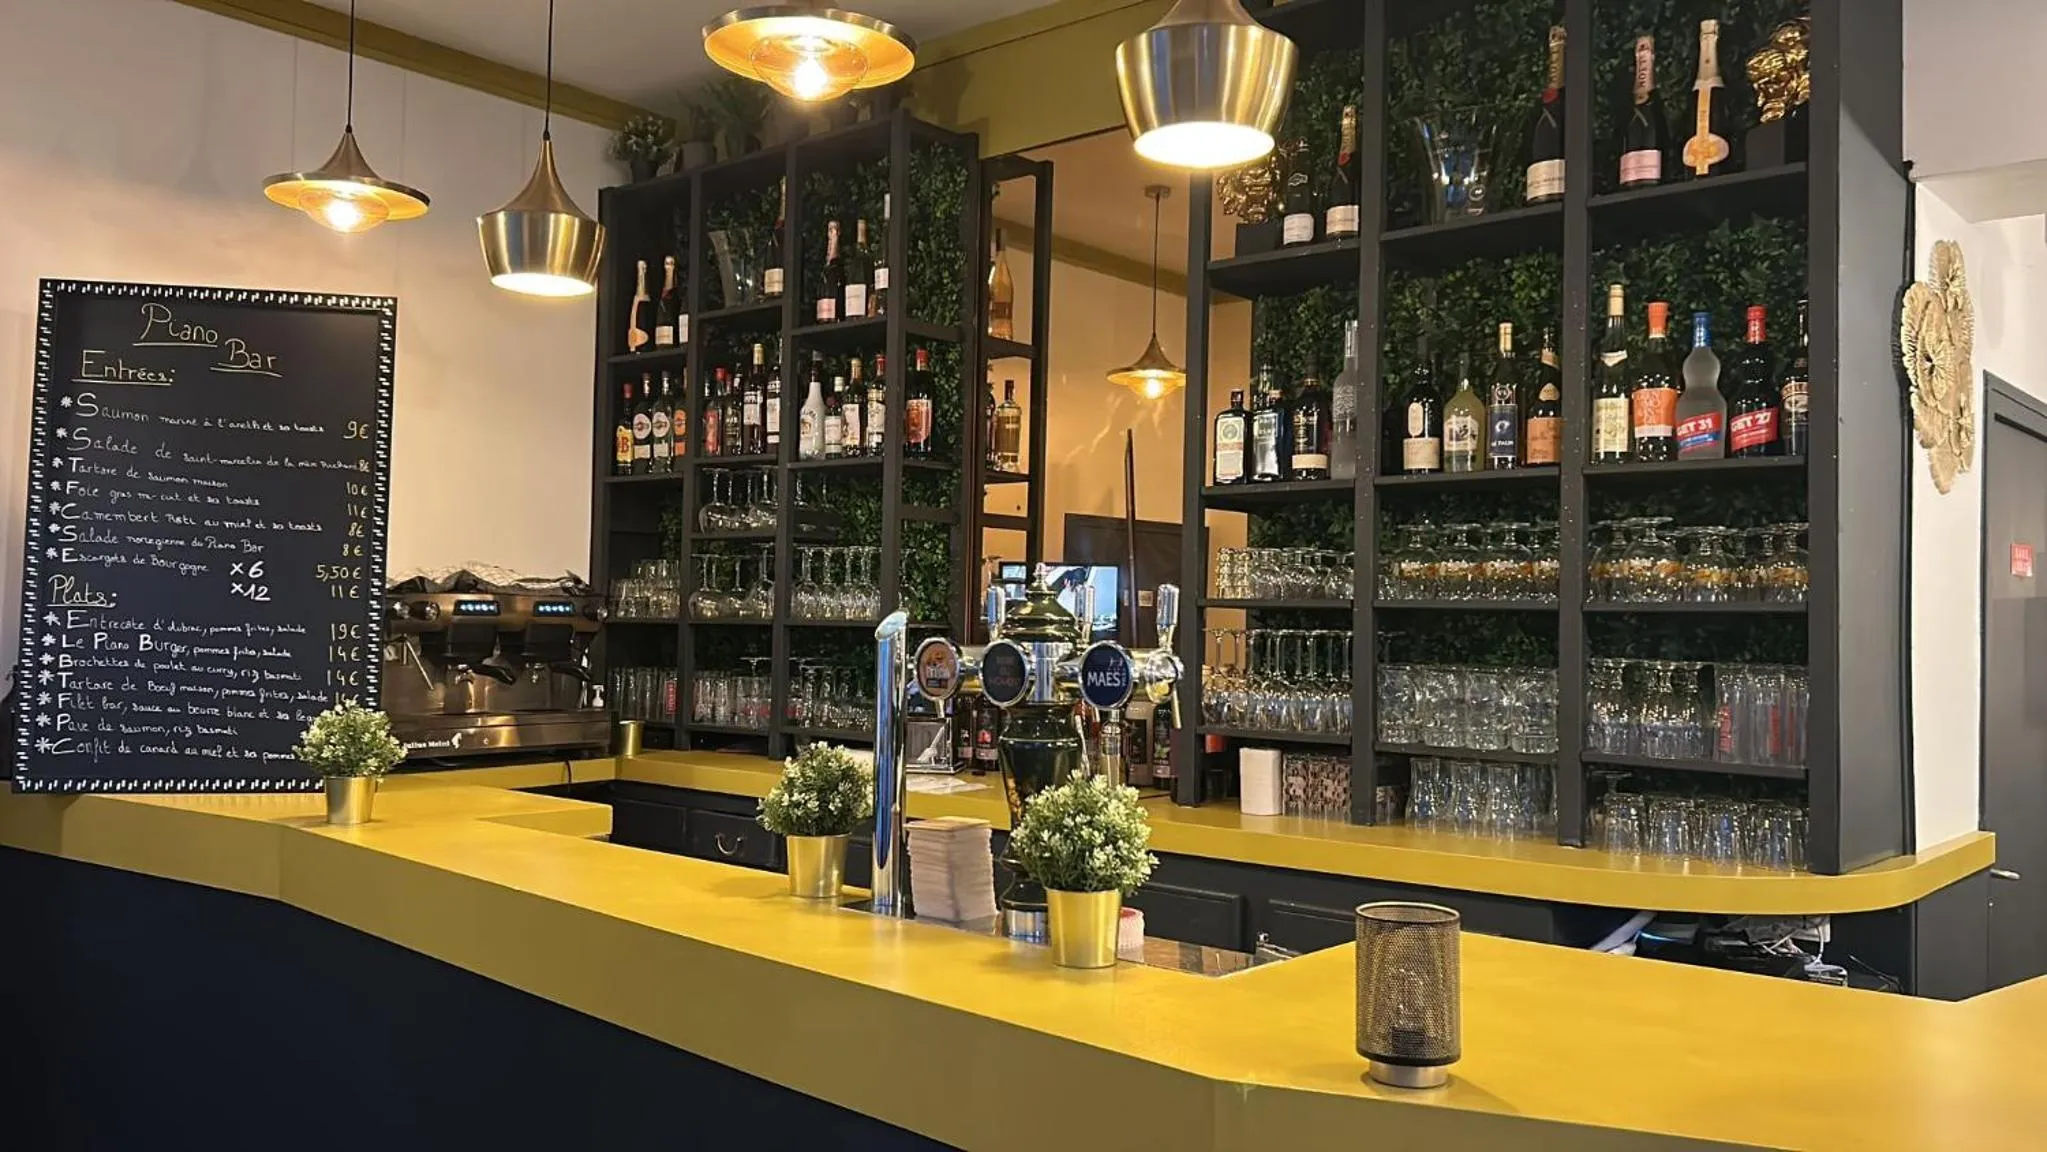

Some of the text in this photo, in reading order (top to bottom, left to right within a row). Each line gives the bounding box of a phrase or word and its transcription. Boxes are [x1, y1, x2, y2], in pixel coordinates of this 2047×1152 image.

[141, 302, 218, 344] Piano
[224, 337, 277, 369] Bar
[75, 392, 149, 423] Saumon
[262, 420, 274, 432] et
[343, 420, 369, 439] 9€
[66, 427, 138, 455] Salade
[155, 441, 172, 459] de
[266, 454, 279, 467] de
[284, 456, 295, 468] la
[359, 459, 370, 473] 8€
[68, 456, 368, 497] Tartare de saumon maison 10€
[66, 480, 99, 497] Foie
[110, 489, 132, 505] gras
[188, 492, 200, 503] et
[226, 494, 260, 507] toasts
[347, 503, 367, 519] 11€
[60, 503, 159, 523] Camembert
[204, 519, 219, 528] au
[223, 517, 251, 529] miel
[255, 519, 268, 530] et
[288, 521, 323, 533] toasts
[349, 522, 365, 538] 8€
[58, 525, 119, 544] Salade
[191, 537, 203, 548] du
[204, 536, 236, 550] Piano
[240, 538, 264, 554] Bar
[62, 547, 127, 568] Escargots
[133, 553, 145, 566] de
[150, 553, 209, 577] Bourgogne
[48, 574, 117, 608] Plats:
[277, 624, 307, 635] salade
[62, 633, 84, 649] Le
[94, 632, 129, 650] Piano
[193, 646, 230, 658] pommes
[262, 647, 292, 658] salade
[59, 654, 129, 668] Brochettes
[134, 658, 146, 669] de
[153, 659, 187, 674] poulet
[191, 665, 204, 673] au
[241, 669, 260, 684] riz
[264, 668, 302, 681] basmati
[1087, 670, 1121, 688] MAES
[57, 672, 114, 691] Tartare
[121, 675, 138, 691] de
[296, 690, 328, 703] salade
[58, 692, 95, 710] Filet
[132, 702, 162, 713] sauce
[187, 701, 220, 716] beurre
[227, 705, 255, 718] blanc
[258, 707, 270, 719] et
[98, 717, 116, 732] de
[173, 725, 193, 738] riz
[197, 724, 238, 736] basmati
[51, 737, 111, 764] Confit
[118, 739, 133, 754] de
[139, 740, 179, 755] canard
[184, 747, 199, 756] au
[202, 744, 223, 759] miel
[226, 746, 240, 759] et
